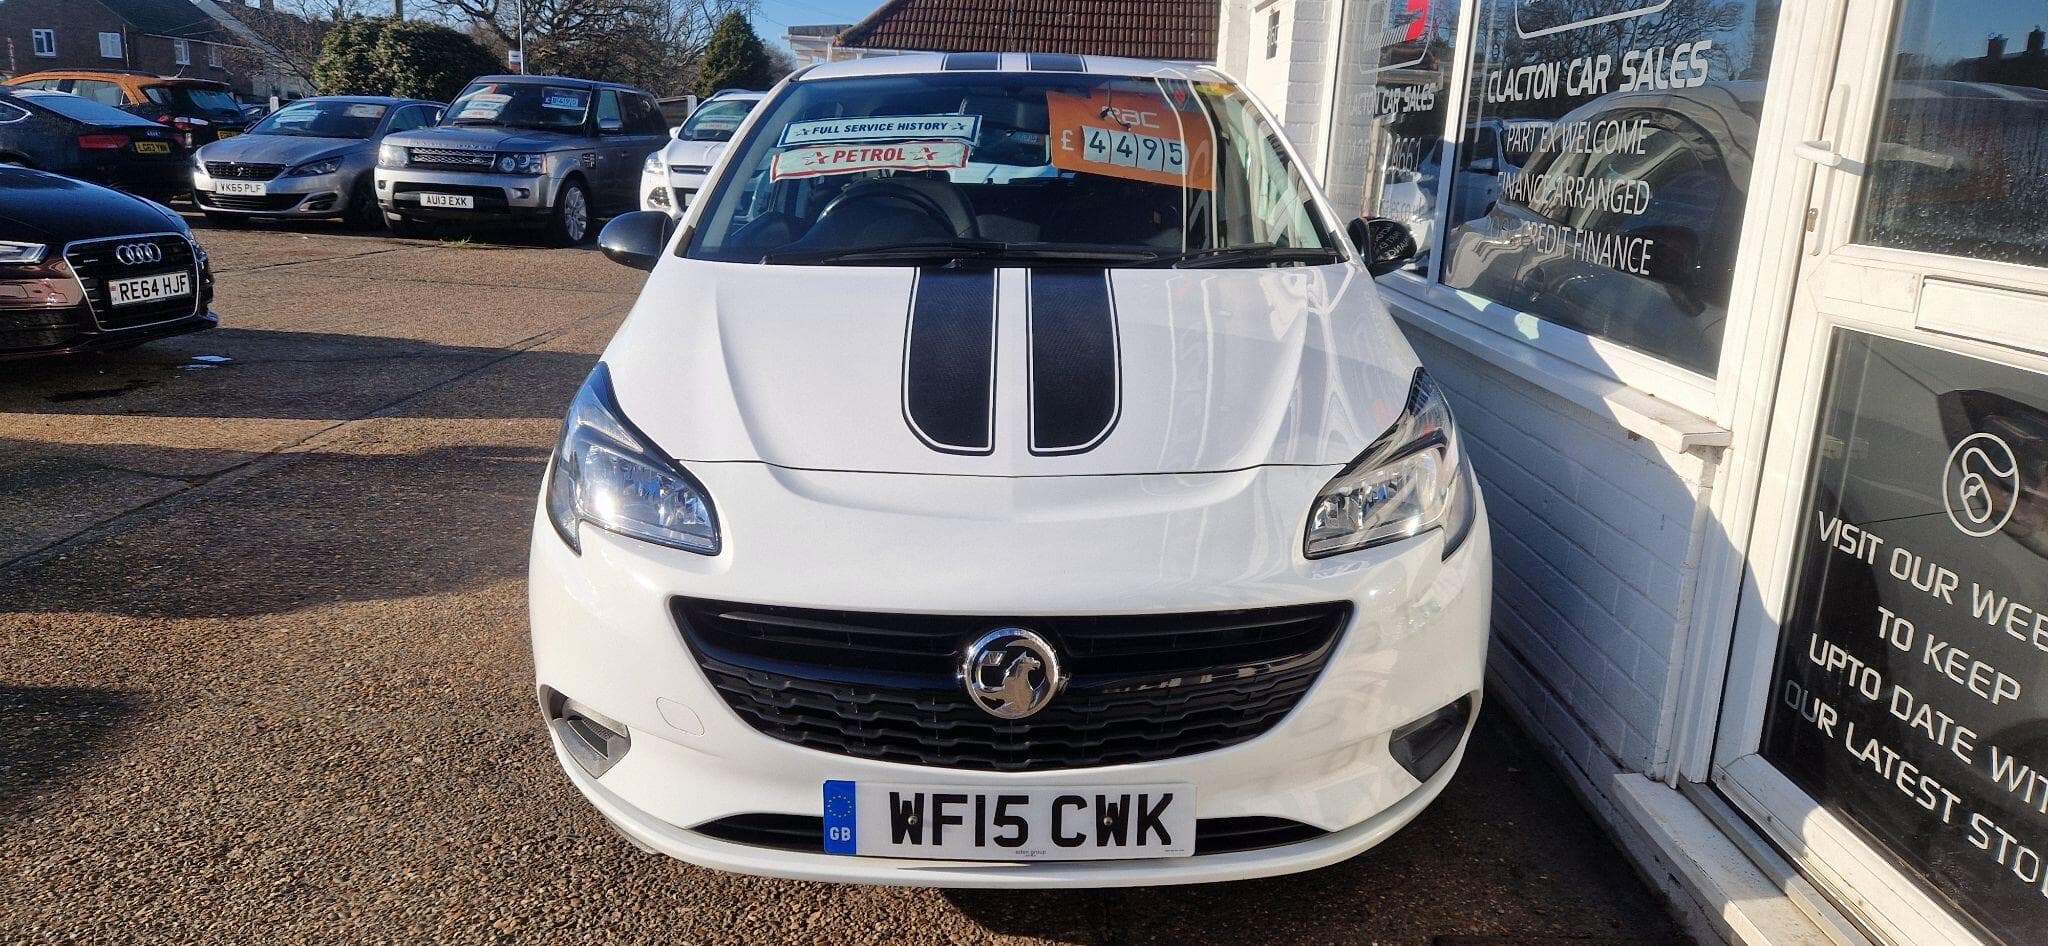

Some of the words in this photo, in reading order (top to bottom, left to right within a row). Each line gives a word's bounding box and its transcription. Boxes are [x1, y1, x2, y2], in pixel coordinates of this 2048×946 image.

[1488, 61, 1561, 104] CLACTON
[1566, 53, 1612, 97] CAR
[1618, 39, 1713, 93] SALES
[1381, 87, 1401, 114] CAR
[1402, 82, 1436, 113] SALES
[812, 125, 840, 135] FULL
[843, 123, 893, 133] SERVICE
[897, 122, 949, 131] HISTORY
[1506, 125, 1537, 153] PART
[1539, 123, 1557, 153] EX
[1562, 119, 1650, 155] WELCOME
[832, 147, 906, 164] PETROL
[220, 183, 243, 193] VK65
[244, 183, 262, 193] PLF
[426, 195, 447, 205] AU13
[448, 196, 467, 206] EXK
[1497, 171, 1552, 205] FINANCE
[1554, 174, 1650, 216] ARRANGED
[1572, 226, 1654, 276] FINANCE
[118, 278, 160, 302] RE64
[162, 274, 187, 295] HJF
[1818, 510, 1884, 565] VISIT
[1889, 547, 1959, 606] OUR
[1877, 605, 1914, 652] TO
[1922, 634, 2021, 706] KEEP
[1809, 633, 1882, 702] UPTO
[1890, 684, 1978, 765] DATE
[1784, 679, 1838, 739] OUR
[1845, 721, 1962, 824] LATEST
[829, 826, 851, 841] GB
[888, 791, 1029, 848] WF15
[1051, 792, 1174, 848] CWK
